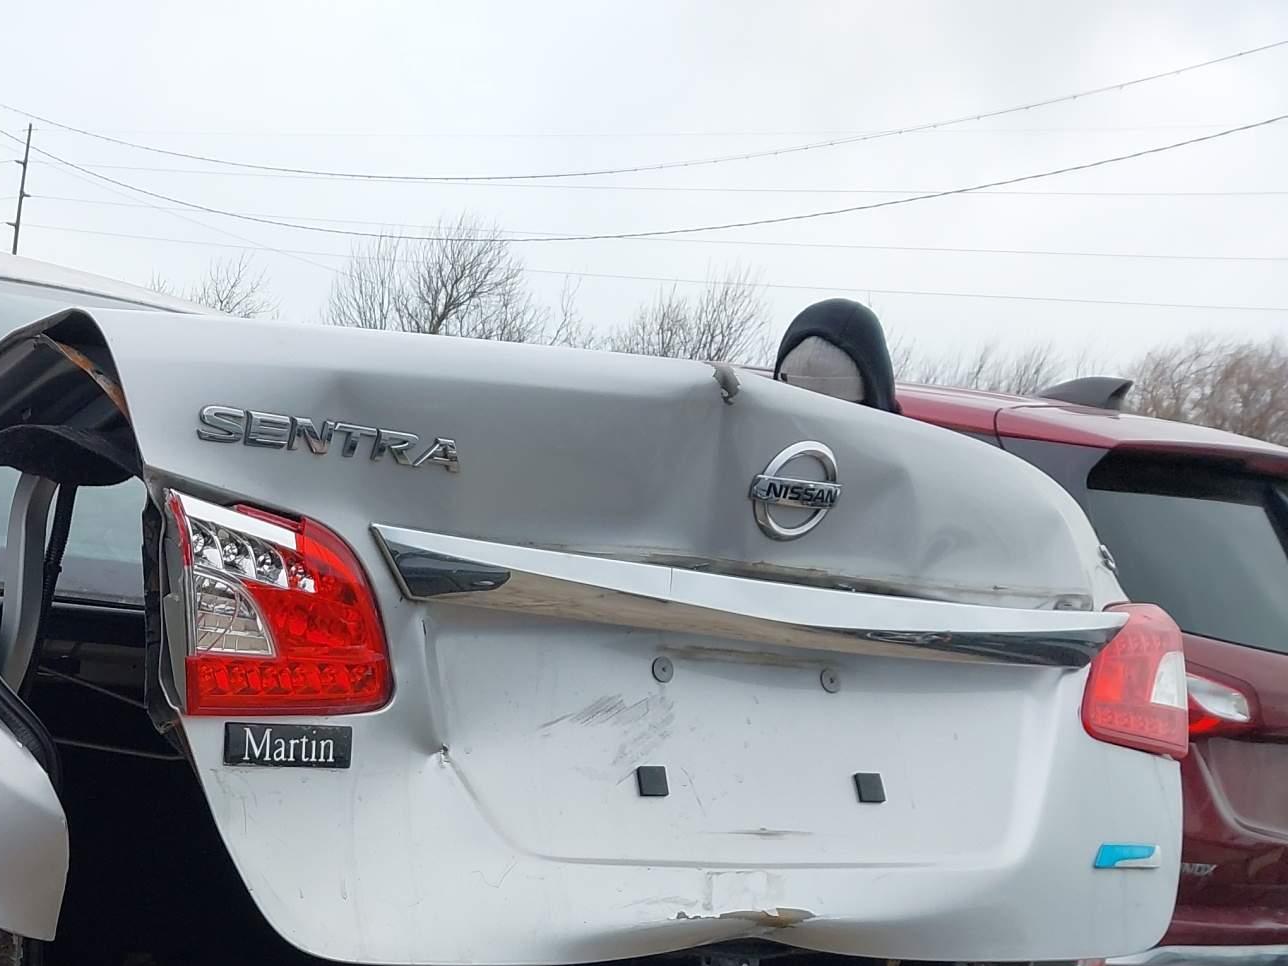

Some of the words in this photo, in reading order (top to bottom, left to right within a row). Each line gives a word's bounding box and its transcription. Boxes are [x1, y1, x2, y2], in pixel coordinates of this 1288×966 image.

[196, 404, 460, 473] SENTRA
[765, 482, 838, 504] NISSAN
[242, 727, 335, 763] Martin
